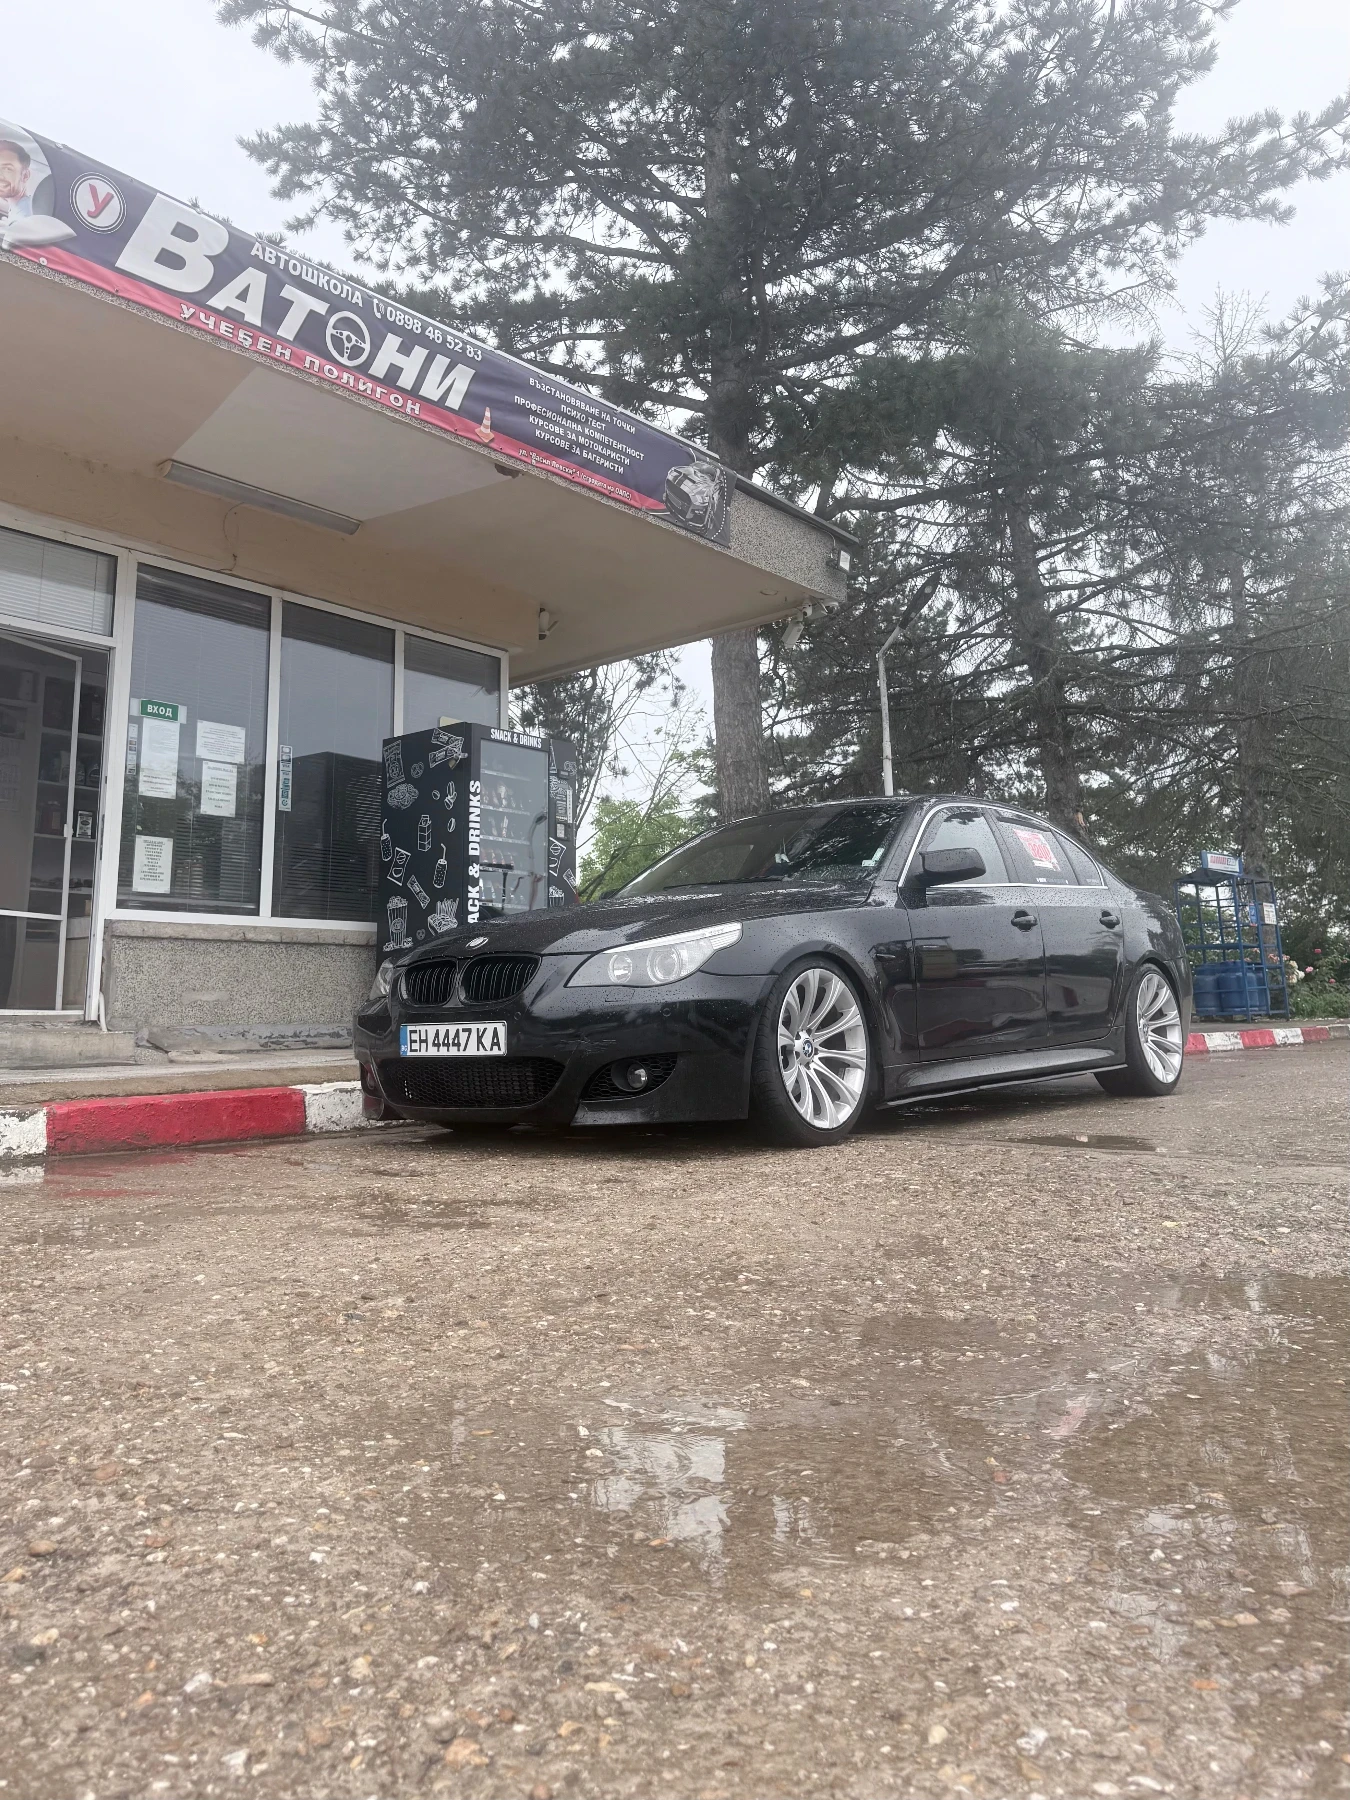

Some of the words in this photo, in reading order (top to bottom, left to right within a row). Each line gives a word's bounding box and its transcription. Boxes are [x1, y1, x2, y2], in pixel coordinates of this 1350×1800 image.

[250, 241, 363, 308] АВТОШКОЛА
[386, 306, 422, 334] 0898
[424, 326, 443, 345] 46
[446, 334, 463, 353] 52
[466, 344, 483, 362] 83
[179, 303, 292, 361] УЧЕБЕН
[303, 355, 421, 416] ПОЛИГОН
[514, 395, 583, 433] ПРОФЕСИОНАЛНА
[584, 427, 645, 461] КОМПЕТЕНТНОСТ
[529, 377, 600, 417] ВЪЗСТАНОВЯВАНЕ
[601, 411, 611, 423] НА
[612, 416, 636, 435] ТОЧКИ
[561, 404, 586, 422] ПСИХО
[587, 417, 606, 431] ТЕСТ
[529, 415, 565, 436] КУРСОВЕ
[566, 430, 577, 441] ЗА
[578, 435, 630, 466] МОТОКАРИСТИ
[535, 429, 570, 451] КУРСОВЕ
[571, 445, 581, 456] ЗА
[582, 449, 624, 475] БАГЕРИСТИ
[146, 704, 173, 718] ВХОД
[490, 728, 512, 743] SNACK
[513, 733, 519, 744] &
[519, 734, 542, 749] DRINKS
[468, 780, 480, 856] DRINKS
[468, 862, 480, 878] &
[467, 885, 480, 923] ACK
